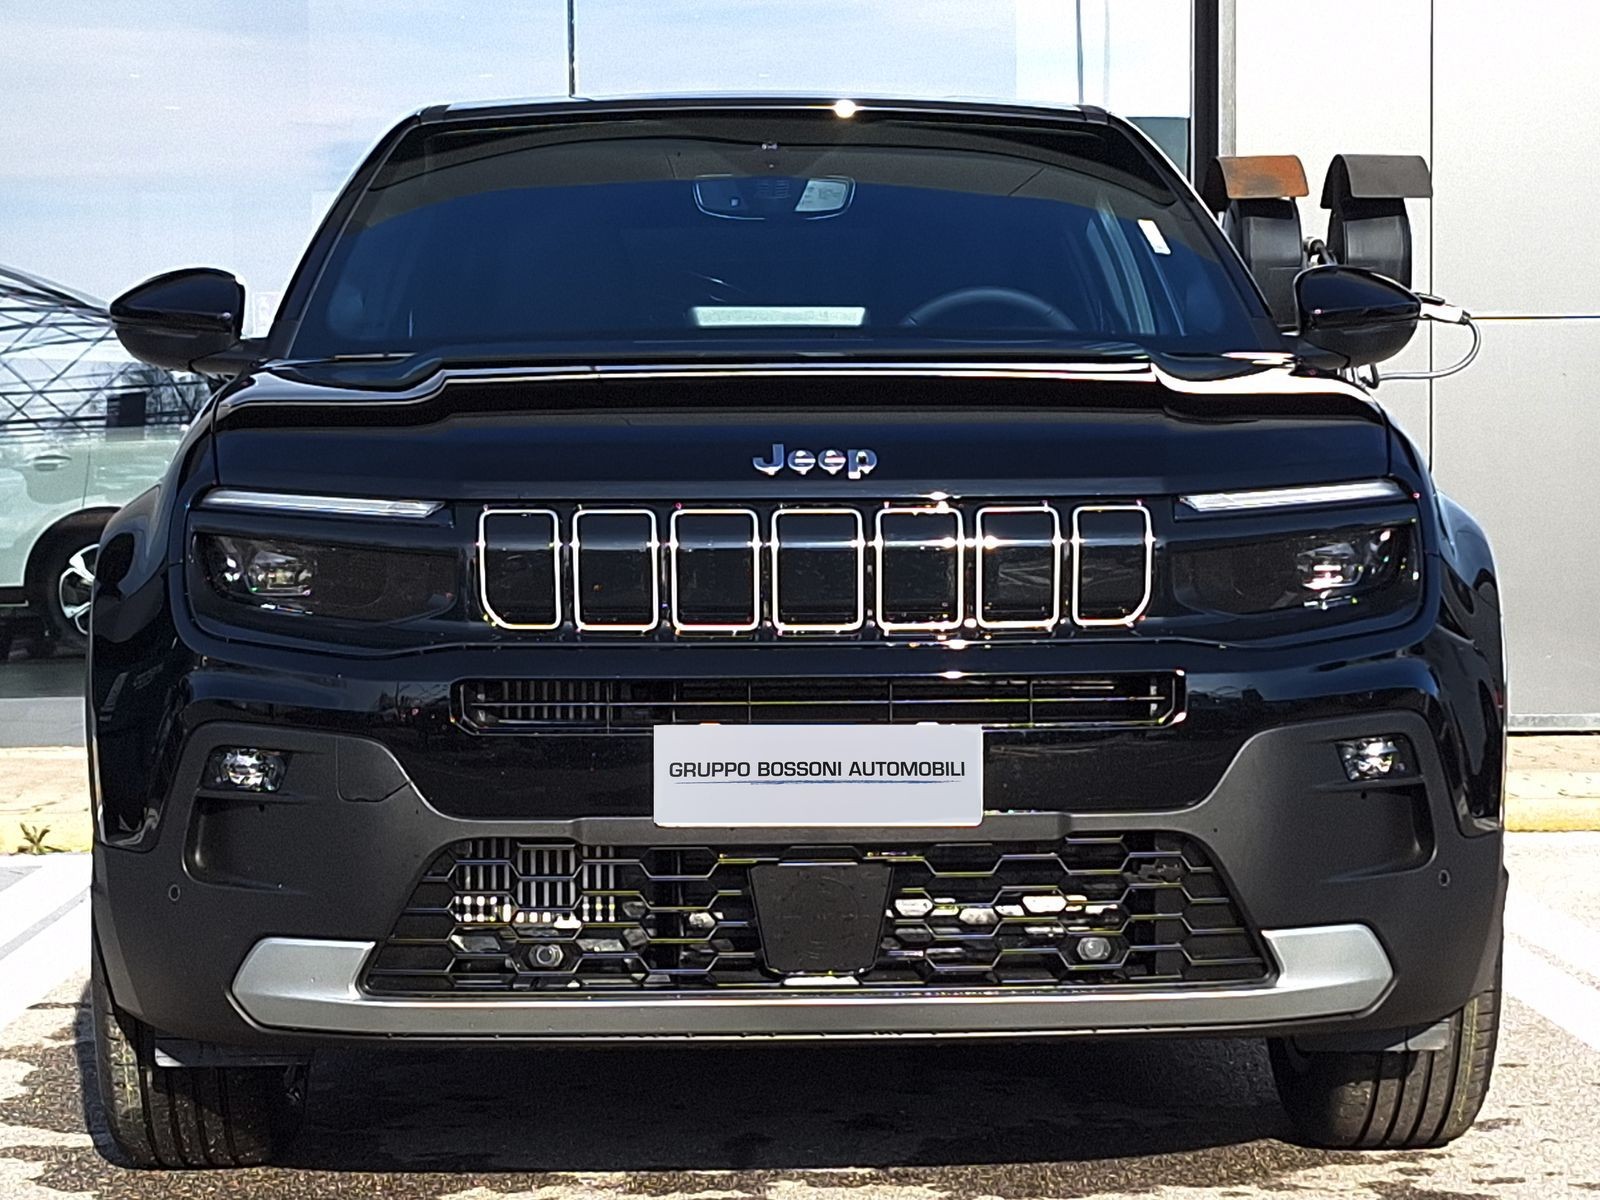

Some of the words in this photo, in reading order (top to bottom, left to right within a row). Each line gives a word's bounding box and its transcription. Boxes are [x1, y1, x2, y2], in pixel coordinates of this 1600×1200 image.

[752, 443, 877, 479] Jeep
[669, 762, 750, 777] GRUPPO
[757, 761, 842, 777] BOSSONI
[848, 761, 965, 777] AUTOMOBILI
